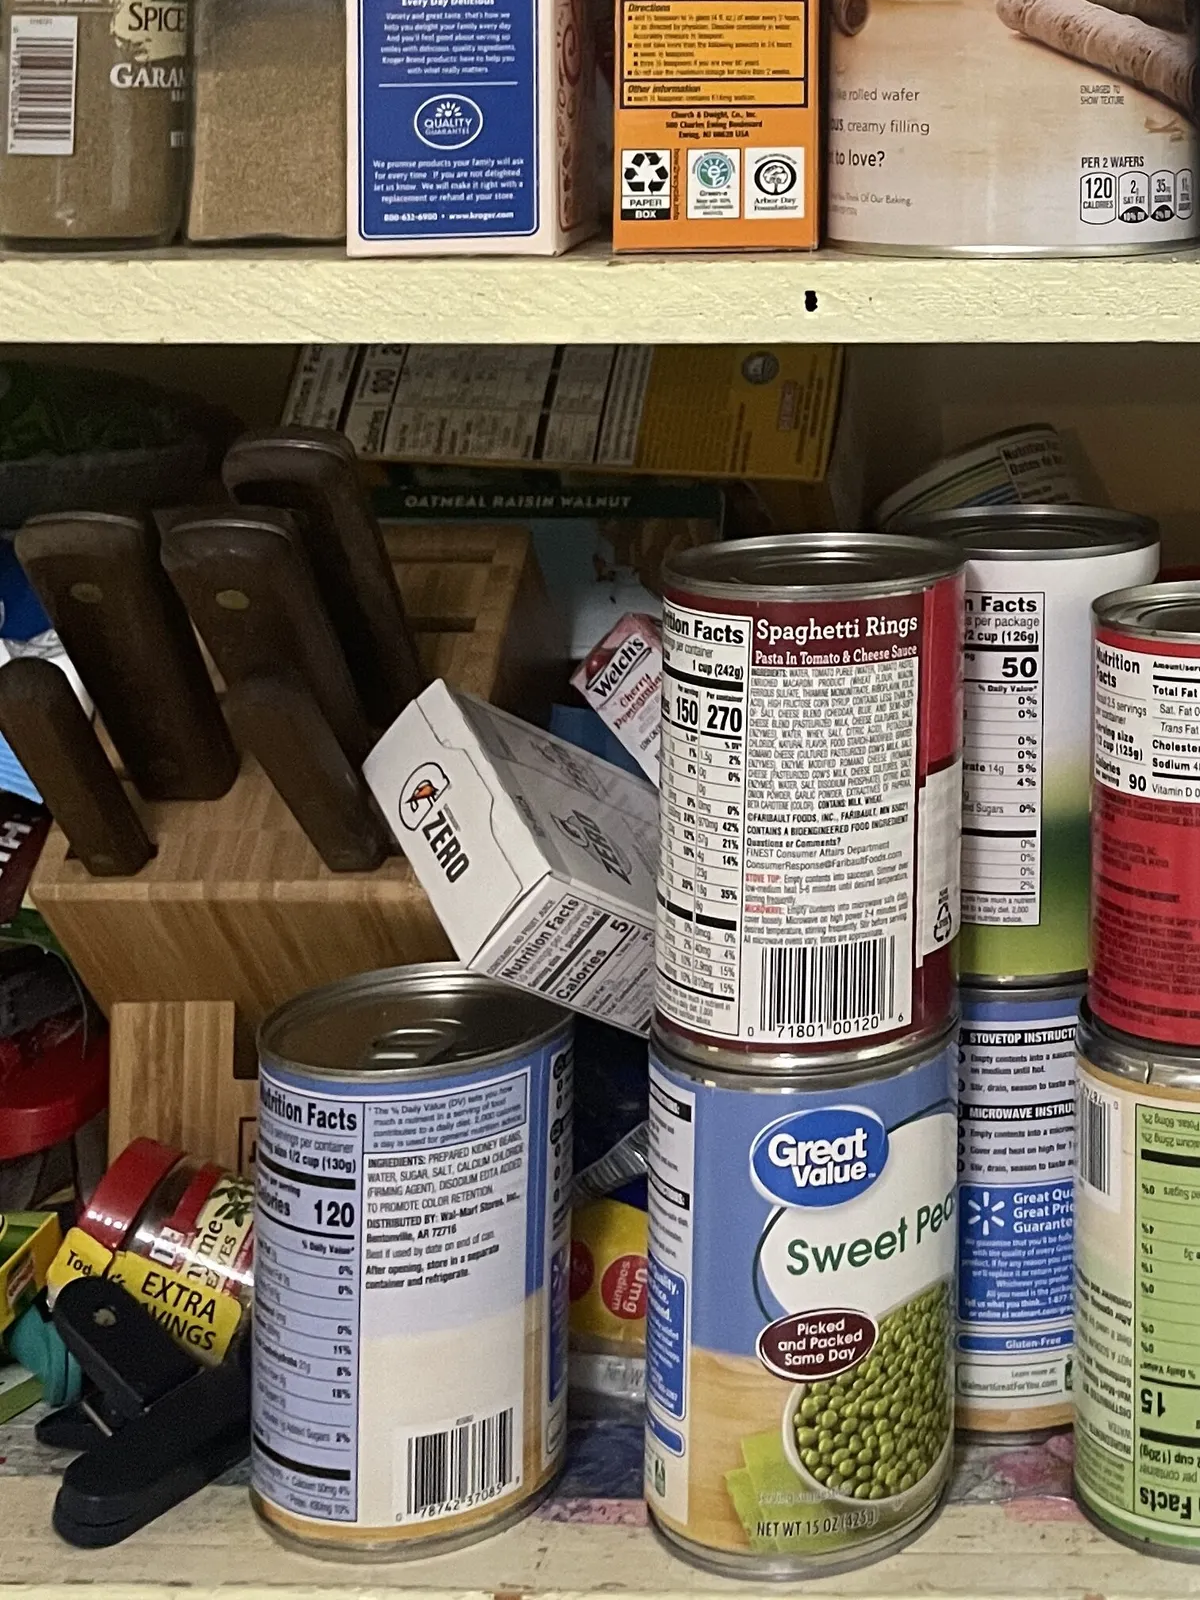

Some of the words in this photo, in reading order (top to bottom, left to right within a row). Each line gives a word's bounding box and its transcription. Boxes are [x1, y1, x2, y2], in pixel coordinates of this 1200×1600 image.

[424, 117, 472, 129] QUALITY
[1085, 177, 1113, 200] 120
[629, 199, 662, 208] PAPER
[635, 210, 656, 219] BOX
[404, 496, 488, 508] OATMEAL
[494, 496, 555, 508] RAISIN
[561, 496, 632, 508] WALNUT
[980, 596, 1038, 612] Facts
[757, 619, 860, 645] Spaghetti
[866, 616, 918, 637] Rings
[756, 651, 783, 664] Pasta
[786, 652, 797, 665] In
[800, 652, 840, 664] Tomato
[842, 651, 851, 662] &
[853, 648, 889, 661] Cheese
[891, 644, 917, 658] Sauce
[593, 637, 645, 699] Welch's
[1000, 656, 1038, 678] 50
[676, 696, 698, 725] 150
[707, 705, 742, 732] 270
[1128, 774, 1147, 792] 90
[423, 812, 469, 883] ZERO
[502, 931, 551, 979] Nutrition
[546, 899, 579, 931] Facts
[556, 950, 607, 1000] Calories
[610, 919, 628, 933] 5
[970, 1030, 1020, 1045] STOVETOP
[307, 1104, 358, 1132] Facts
[768, 1128, 868, 1168] Great
[793, 1160, 866, 1188] Value
[314, 1200, 355, 1228] 120
[786, 1219, 907, 1276] Sweet
[141, 1271, 216, 1324] EXTRA
[797, 1319, 846, 1335] Picked
[778, 1337, 801, 1351] and
[804, 1329, 863, 1349] Packed
[1005, 1337, 1062, 1350] Gluten-Free
[784, 1350, 825, 1365] Same
[829, 1346, 856, 1363] Day
[1141, 1389, 1167, 1415] 15
[1140, 1490, 1192, 1518] Facts
